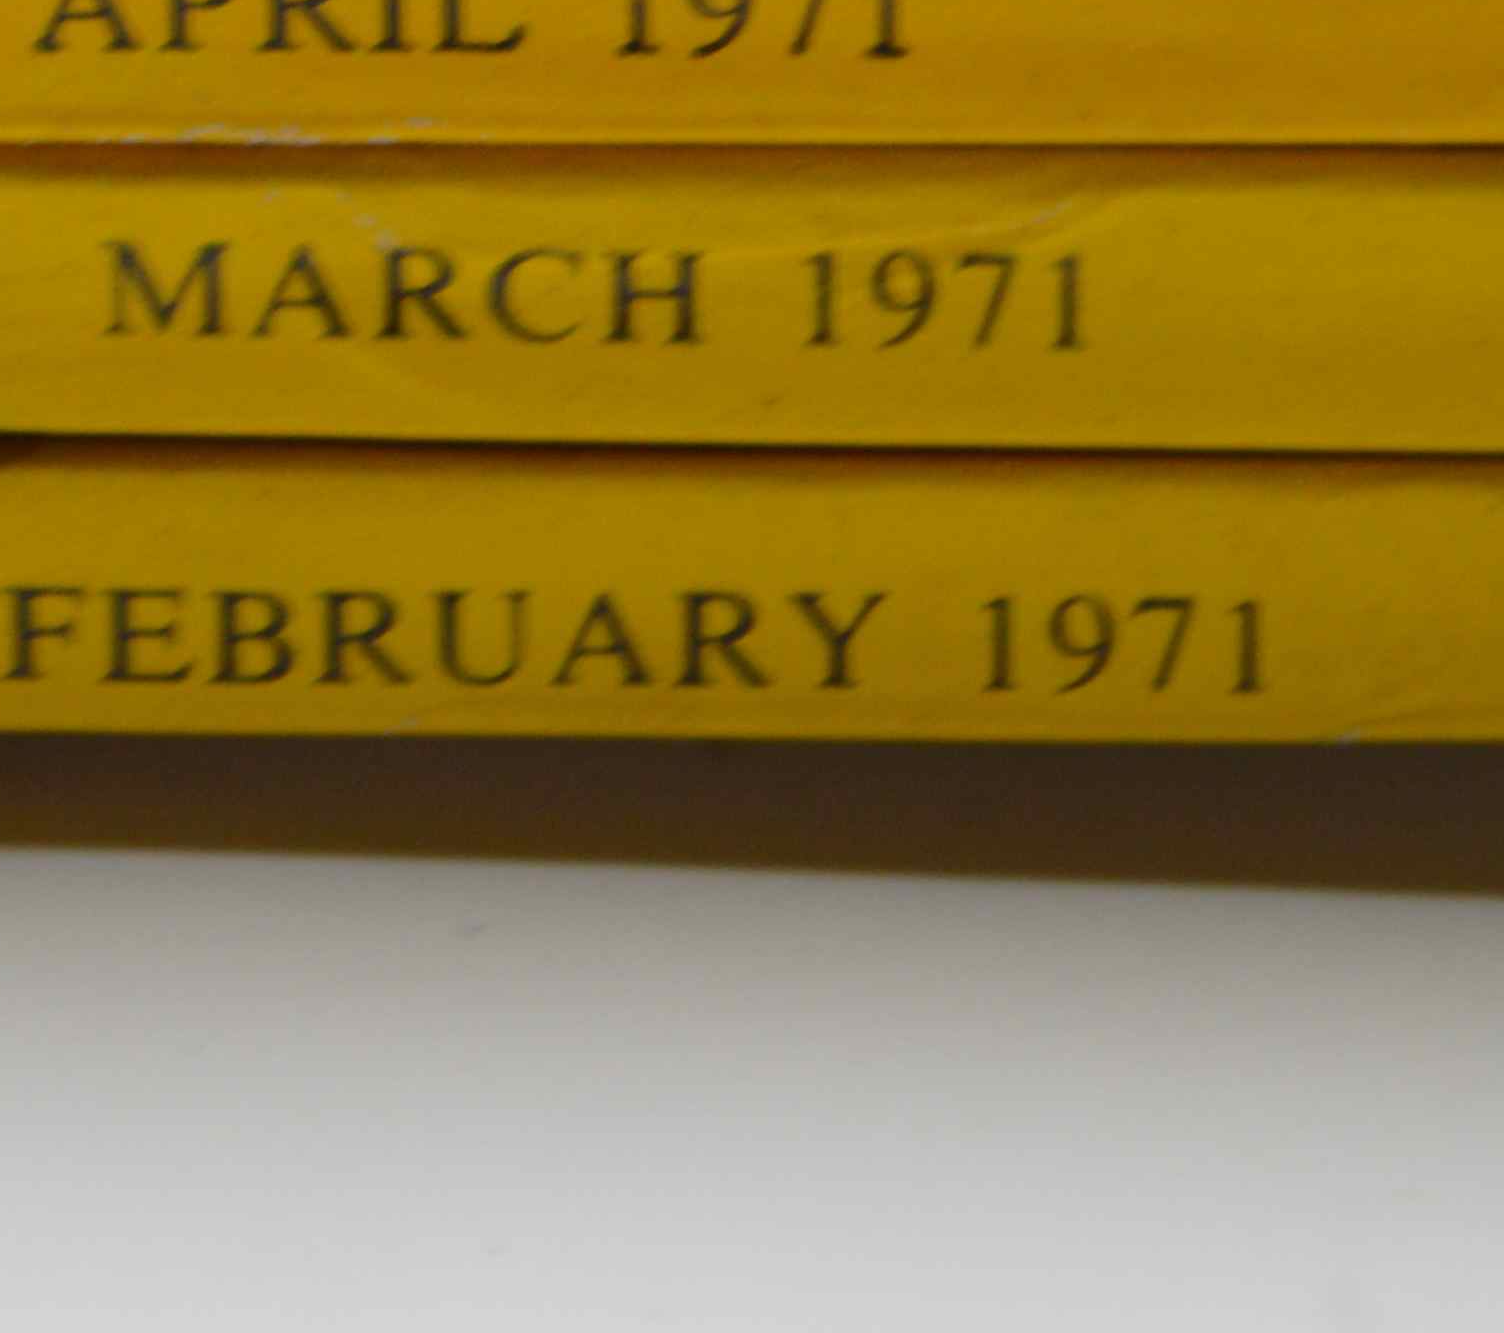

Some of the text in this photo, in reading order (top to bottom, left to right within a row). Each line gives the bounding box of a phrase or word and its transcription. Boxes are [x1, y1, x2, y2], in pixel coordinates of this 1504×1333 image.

[106, 242, 702, 347] MARCH
[807, 250, 1080, 351] 1971
[3, 586, 886, 690] FEBRUARY
[985, 594, 1261, 694] 1971
